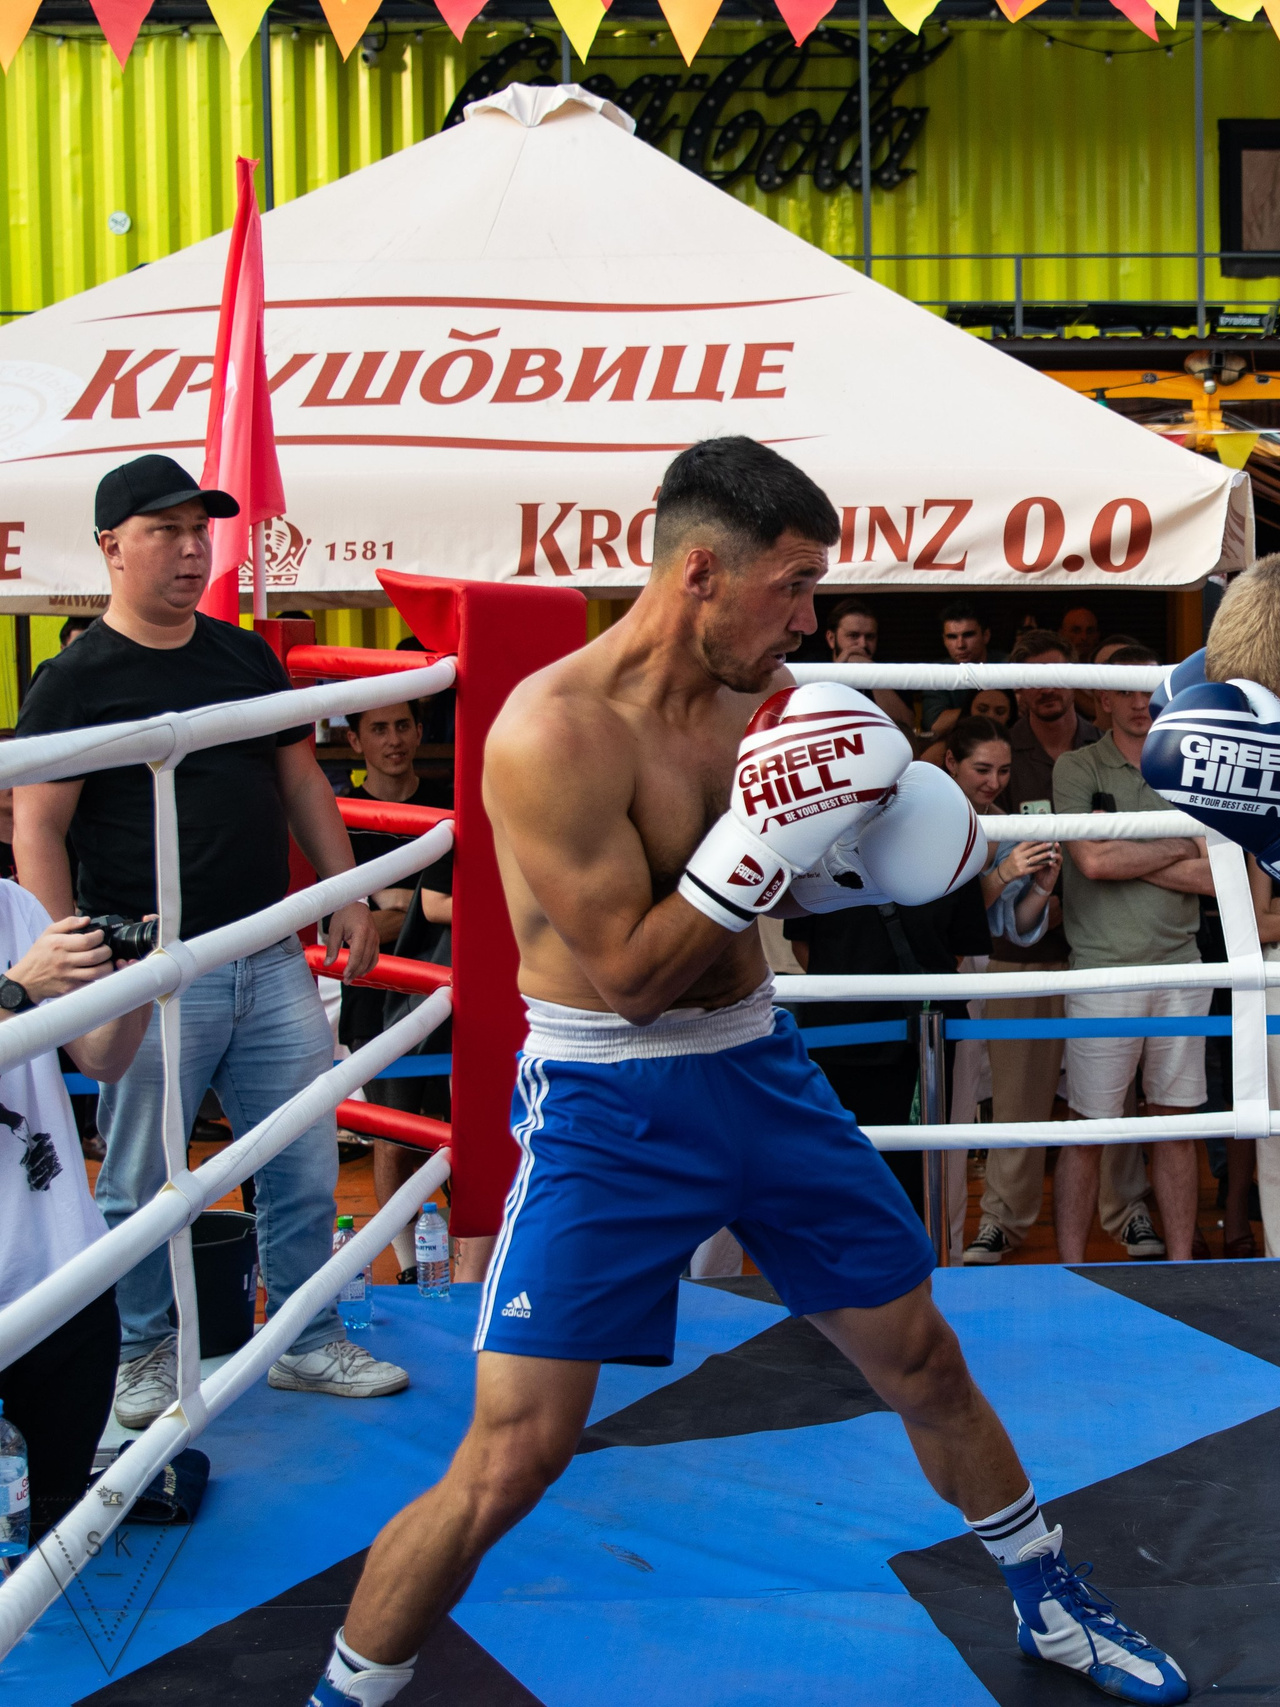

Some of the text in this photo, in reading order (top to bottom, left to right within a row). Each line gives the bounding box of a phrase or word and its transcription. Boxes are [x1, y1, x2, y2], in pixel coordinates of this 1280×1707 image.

[325, 540, 394, 561] 1581
[1003, 496, 1153, 573] 0.0
[738, 733, 865, 789] GREEN
[742, 764, 852, 817] HILL
[784, 793, 858, 822] BE YOUR BEST SELF
[1189, 794, 1261, 812] BE YOUR BEST SELF
